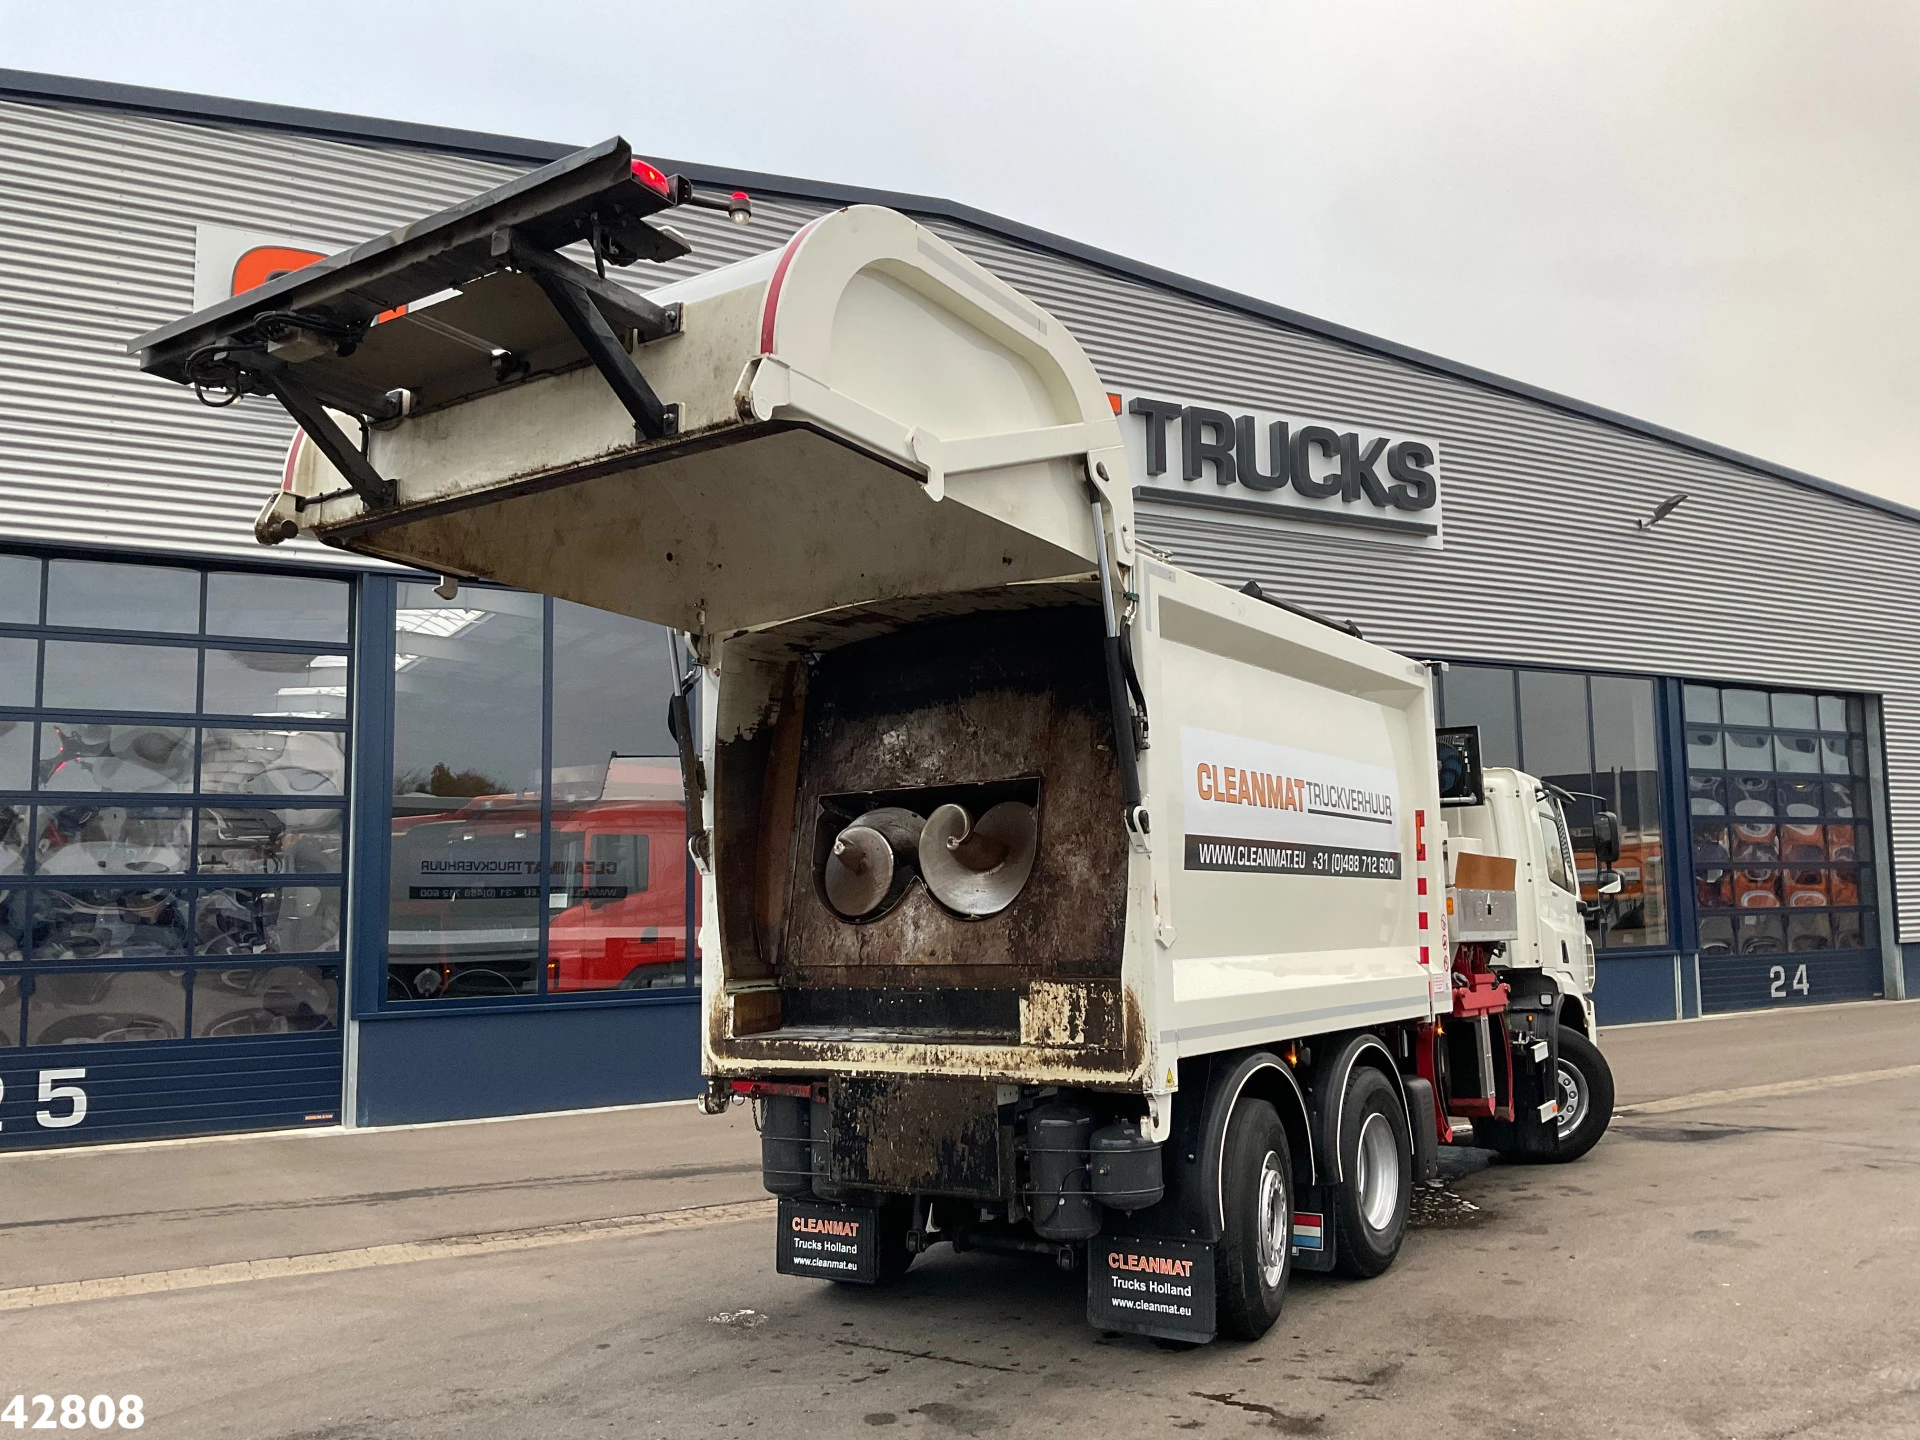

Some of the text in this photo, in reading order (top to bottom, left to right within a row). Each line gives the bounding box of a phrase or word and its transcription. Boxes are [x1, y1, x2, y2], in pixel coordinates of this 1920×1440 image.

[1129, 397, 1437, 511] TRUCKS
[1197, 763, 1392, 816] CLEANMAT TRUCKVERHUUR
[1199, 843, 1395, 874] WWW.CLEANMAT.EU +31 (0)488 712 600
[1769, 964, 1810, 998] 24
[791, 1216, 859, 1237] CLEANMAT
[793, 1238, 858, 1254] Trucks Holland
[793, 1256, 858, 1271] www.cleanmat.eu
[1108, 1252, 1193, 1277] CLEANMAT
[1111, 1275, 1192, 1297] Trucks Holland
[1111, 1297, 1192, 1316] www.cleanmat.eu
